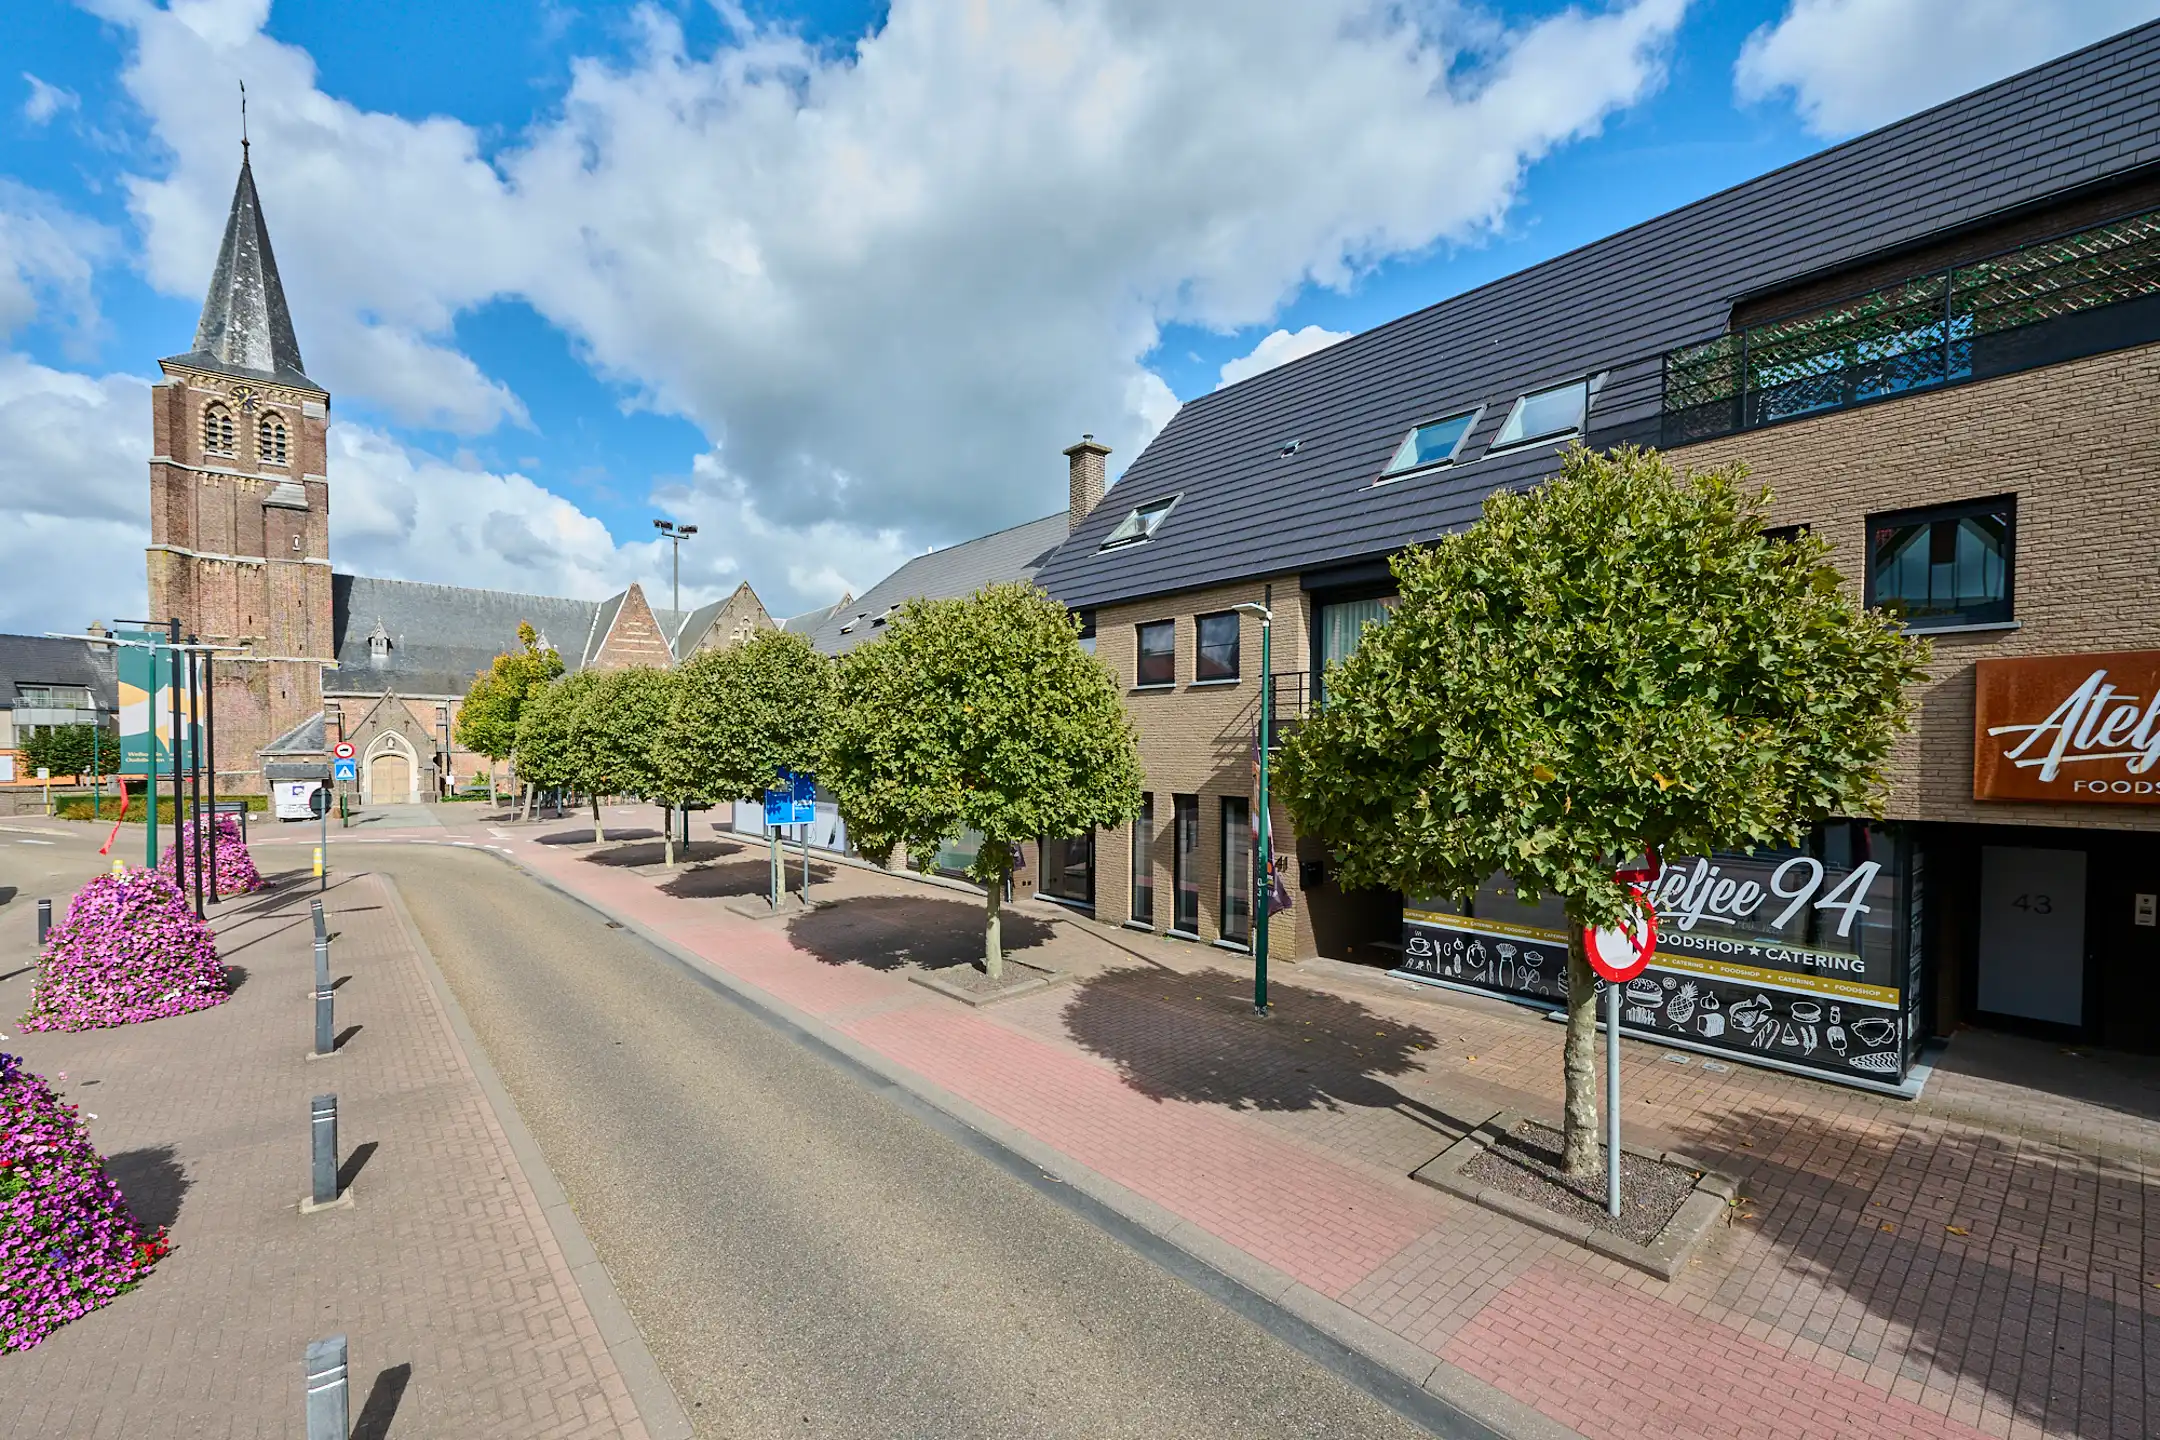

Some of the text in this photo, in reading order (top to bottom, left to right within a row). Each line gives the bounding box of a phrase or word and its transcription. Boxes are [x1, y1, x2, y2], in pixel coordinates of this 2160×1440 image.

[1275, 856, 1288, 873] 41
[1630, 856, 1882, 938] teljee 94
[2011, 894, 2052, 914] 43
[1656, 932, 1865, 973] OODSHOP CATERING
[1672, 958, 1881, 997] CATERING FOODSHOP CATERING FOODSHOP
